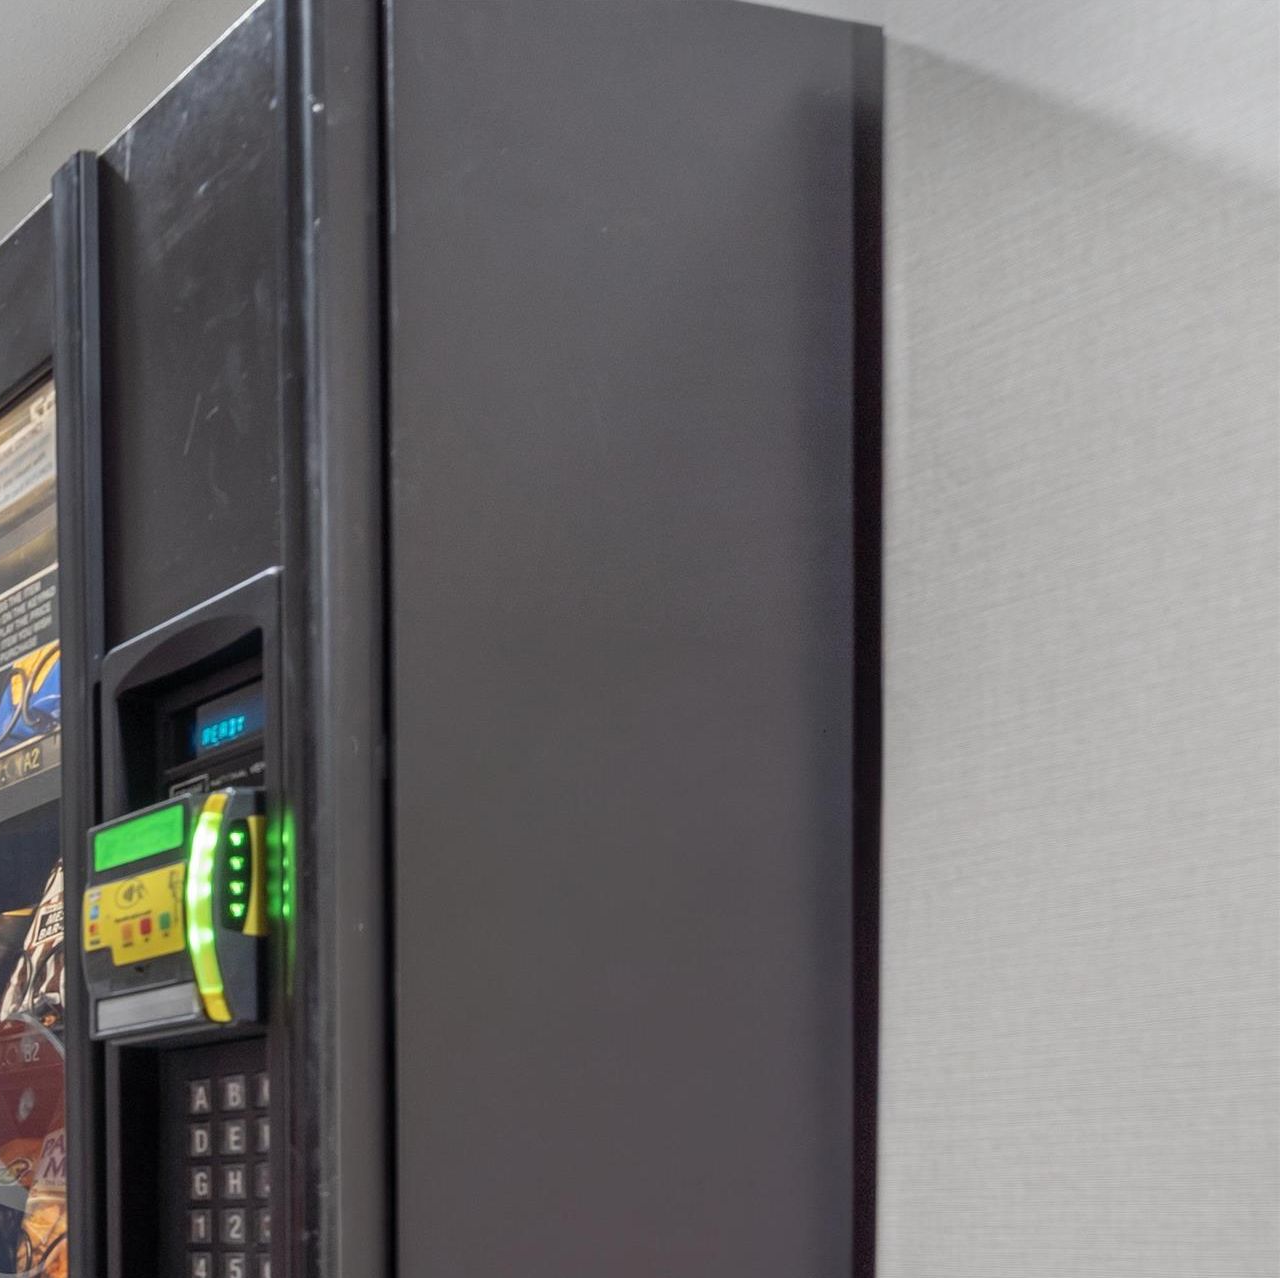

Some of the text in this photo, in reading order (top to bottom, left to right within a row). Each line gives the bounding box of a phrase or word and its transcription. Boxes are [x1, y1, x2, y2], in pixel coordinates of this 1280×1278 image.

[195, 1081, 240, 1113] A B
[196, 1126, 242, 1153] D E
[195, 1170, 242, 1196] G H
[197, 1215, 242, 1239] 1 2
